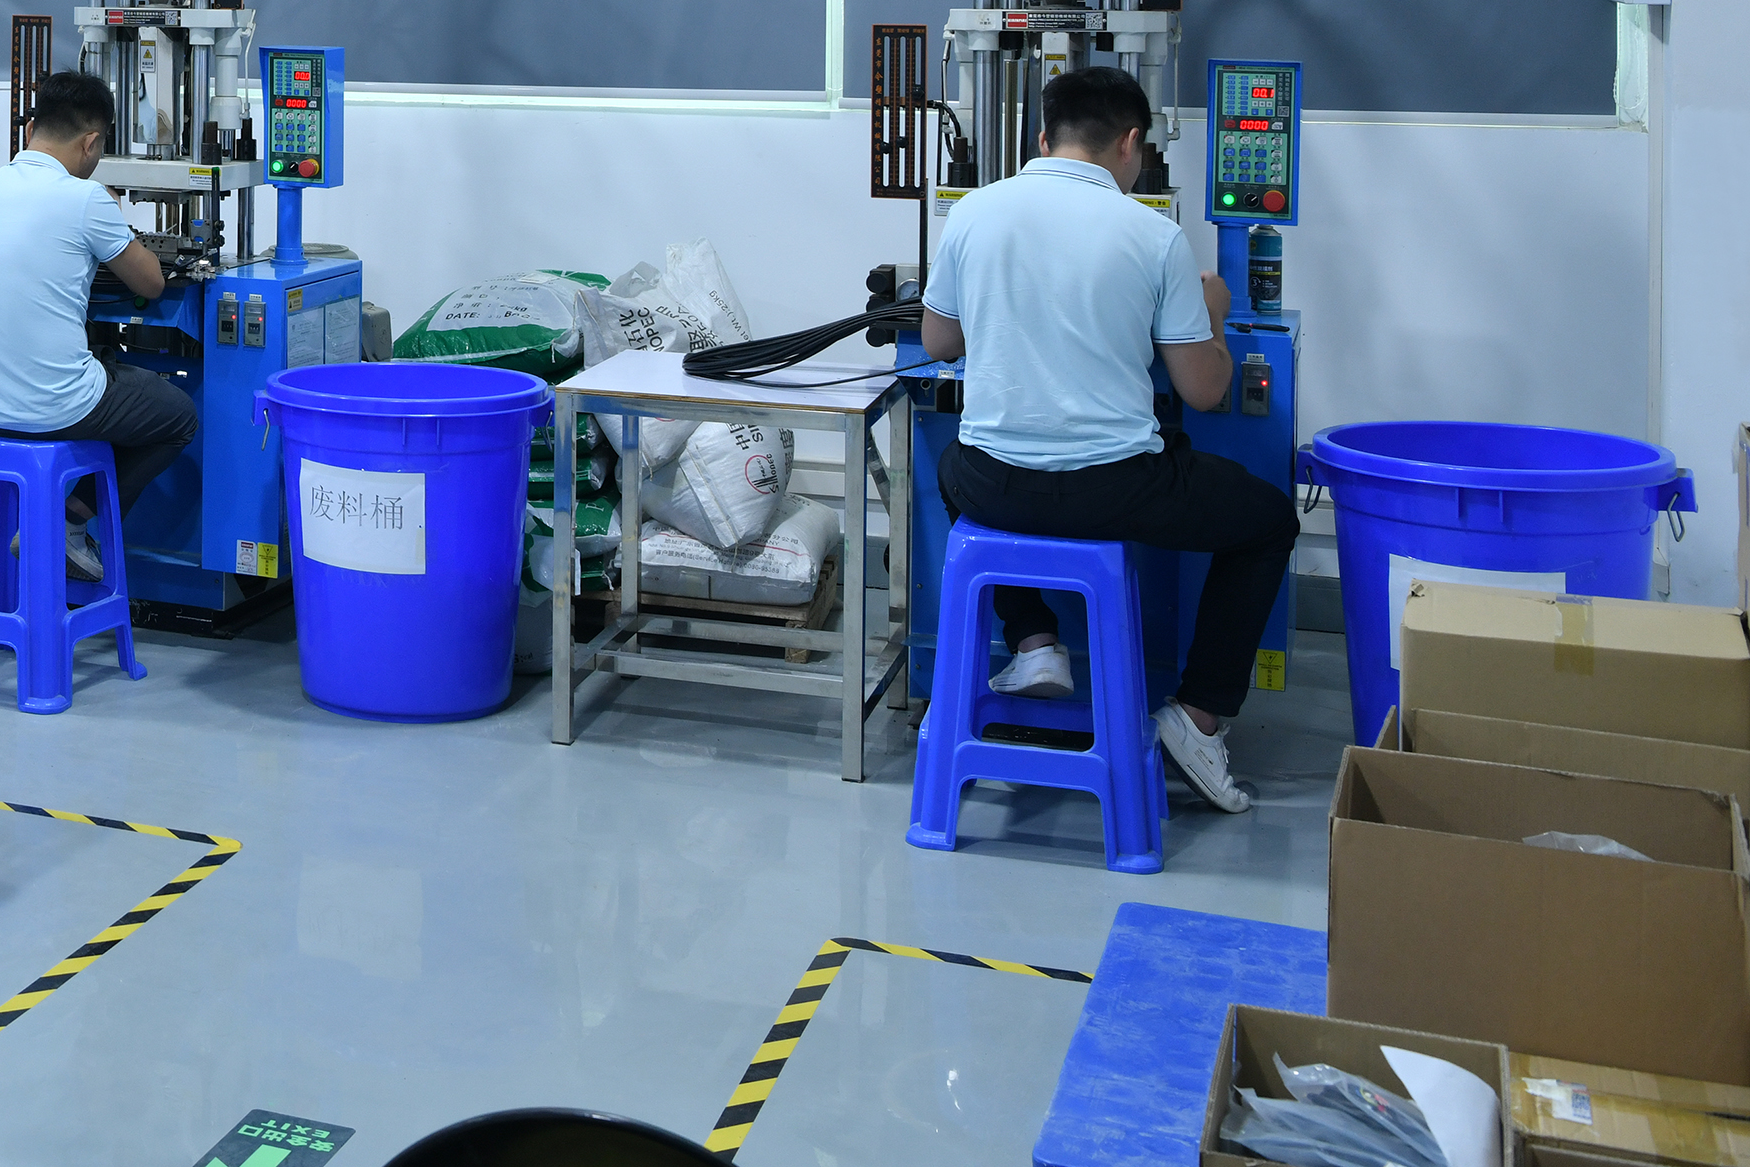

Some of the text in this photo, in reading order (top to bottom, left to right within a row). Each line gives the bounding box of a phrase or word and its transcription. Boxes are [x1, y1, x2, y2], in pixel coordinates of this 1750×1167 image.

[286, 98, 307, 108] 0000
[1239, 119, 1269, 131] 0000
[309, 484, 404, 530] 废料桶
[237, 1124, 335, 1153] 安全出口
[261, 1119, 331, 1139] EXIT
